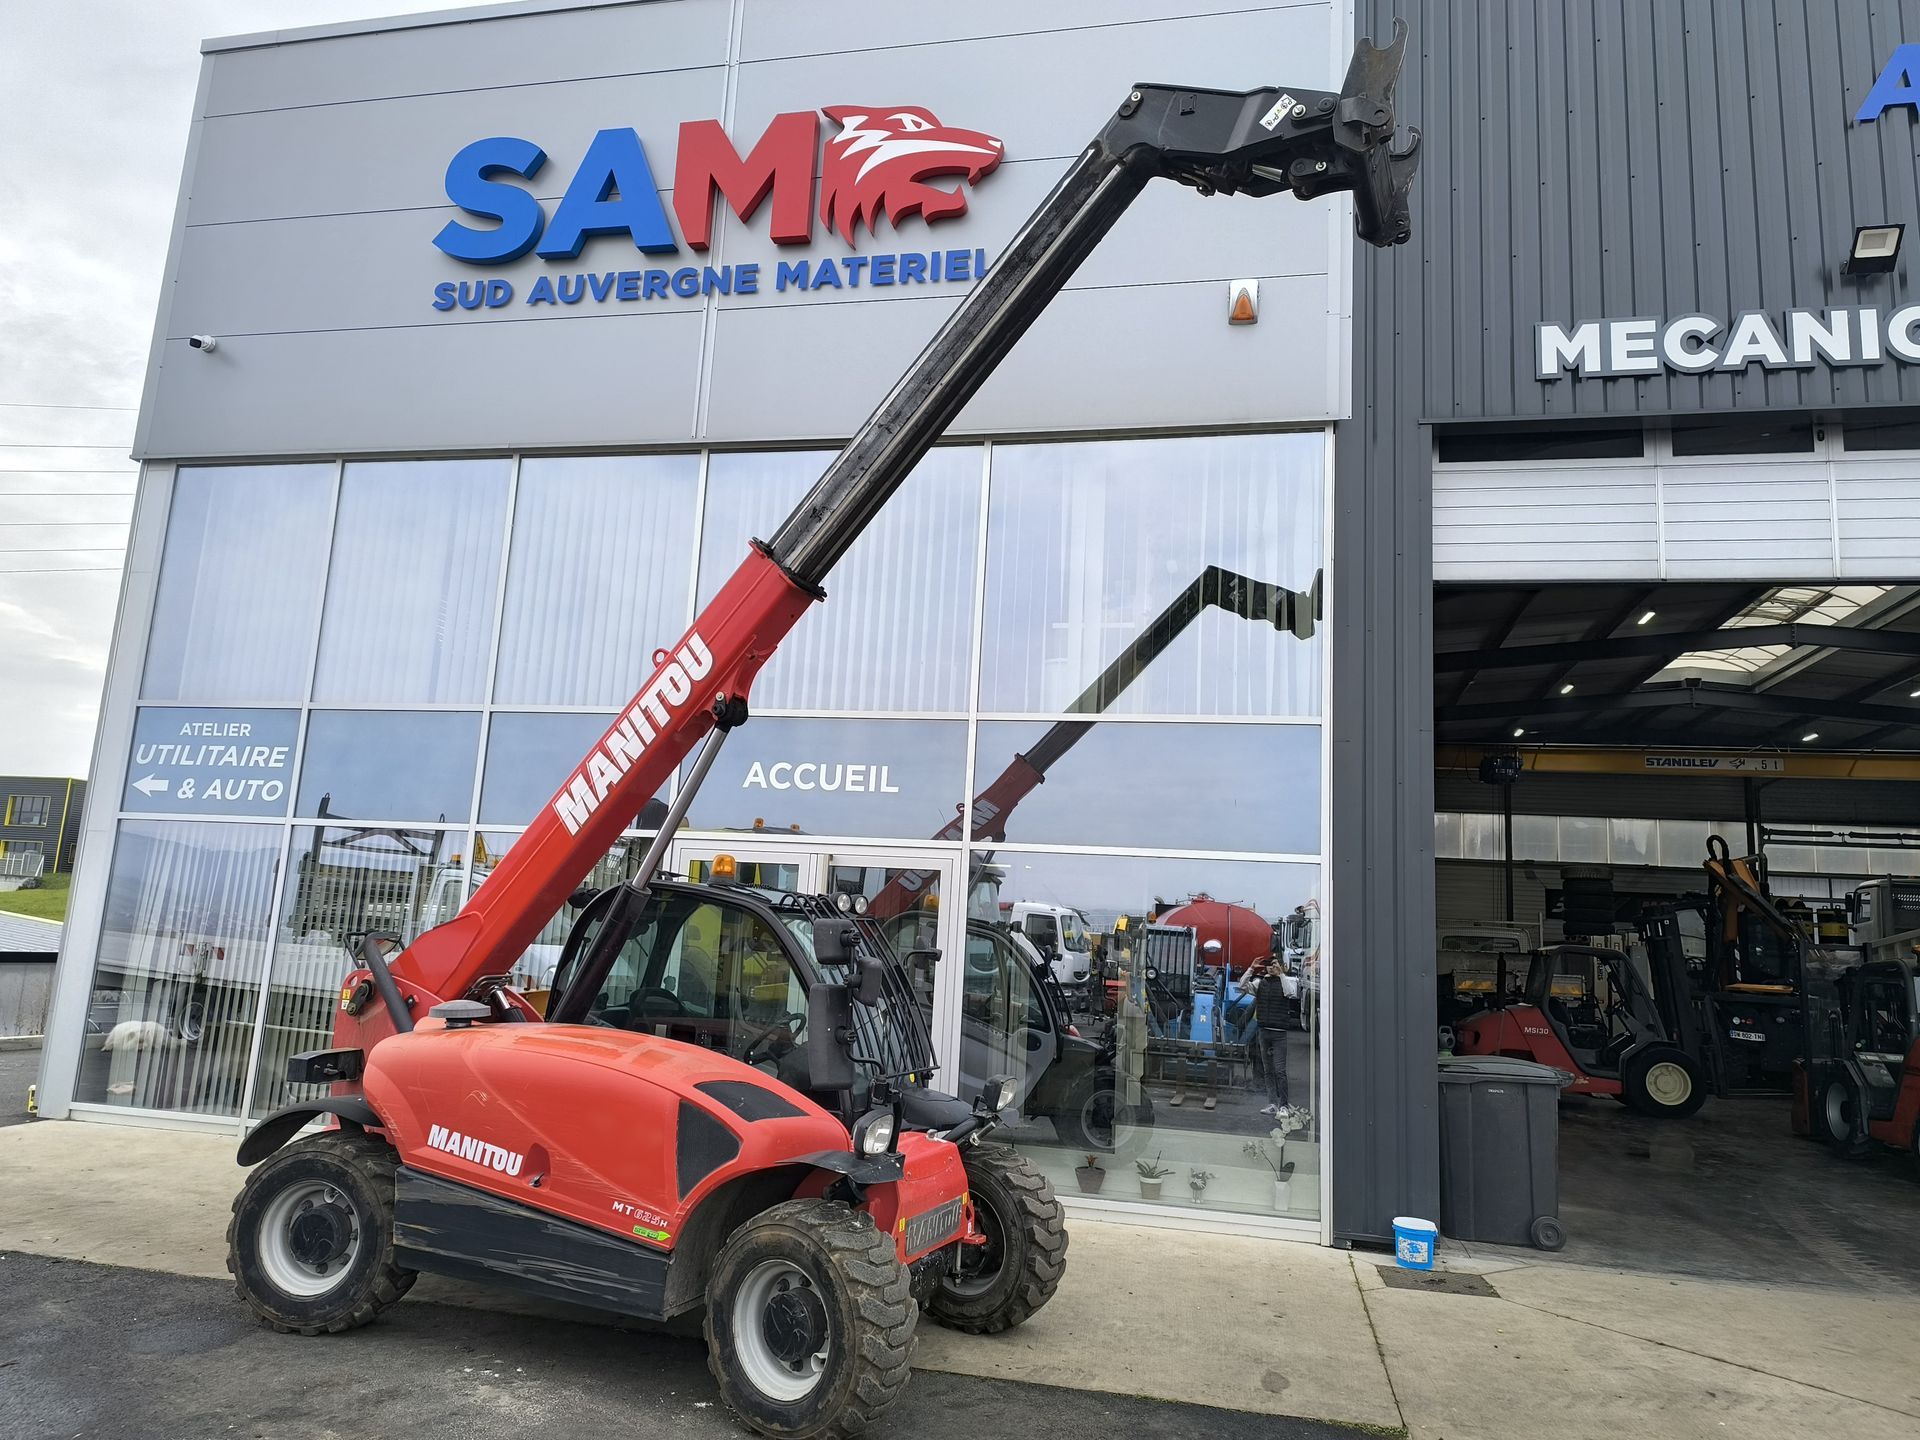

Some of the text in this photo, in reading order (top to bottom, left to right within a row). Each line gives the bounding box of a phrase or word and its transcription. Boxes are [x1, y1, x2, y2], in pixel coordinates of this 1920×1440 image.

[432, 110, 820, 265] SAM
[432, 248, 989, 311] SUD AUVERGNE MATERIEL
[180, 722, 251, 737] ATELIER
[552, 631, 714, 837] MANITOU
[136, 744, 289, 768] UTILITAIRE
[742, 761, 899, 793] ACCUEIL
[177, 778, 284, 801] & AUTO
[427, 1123, 524, 1176] MANITOU
